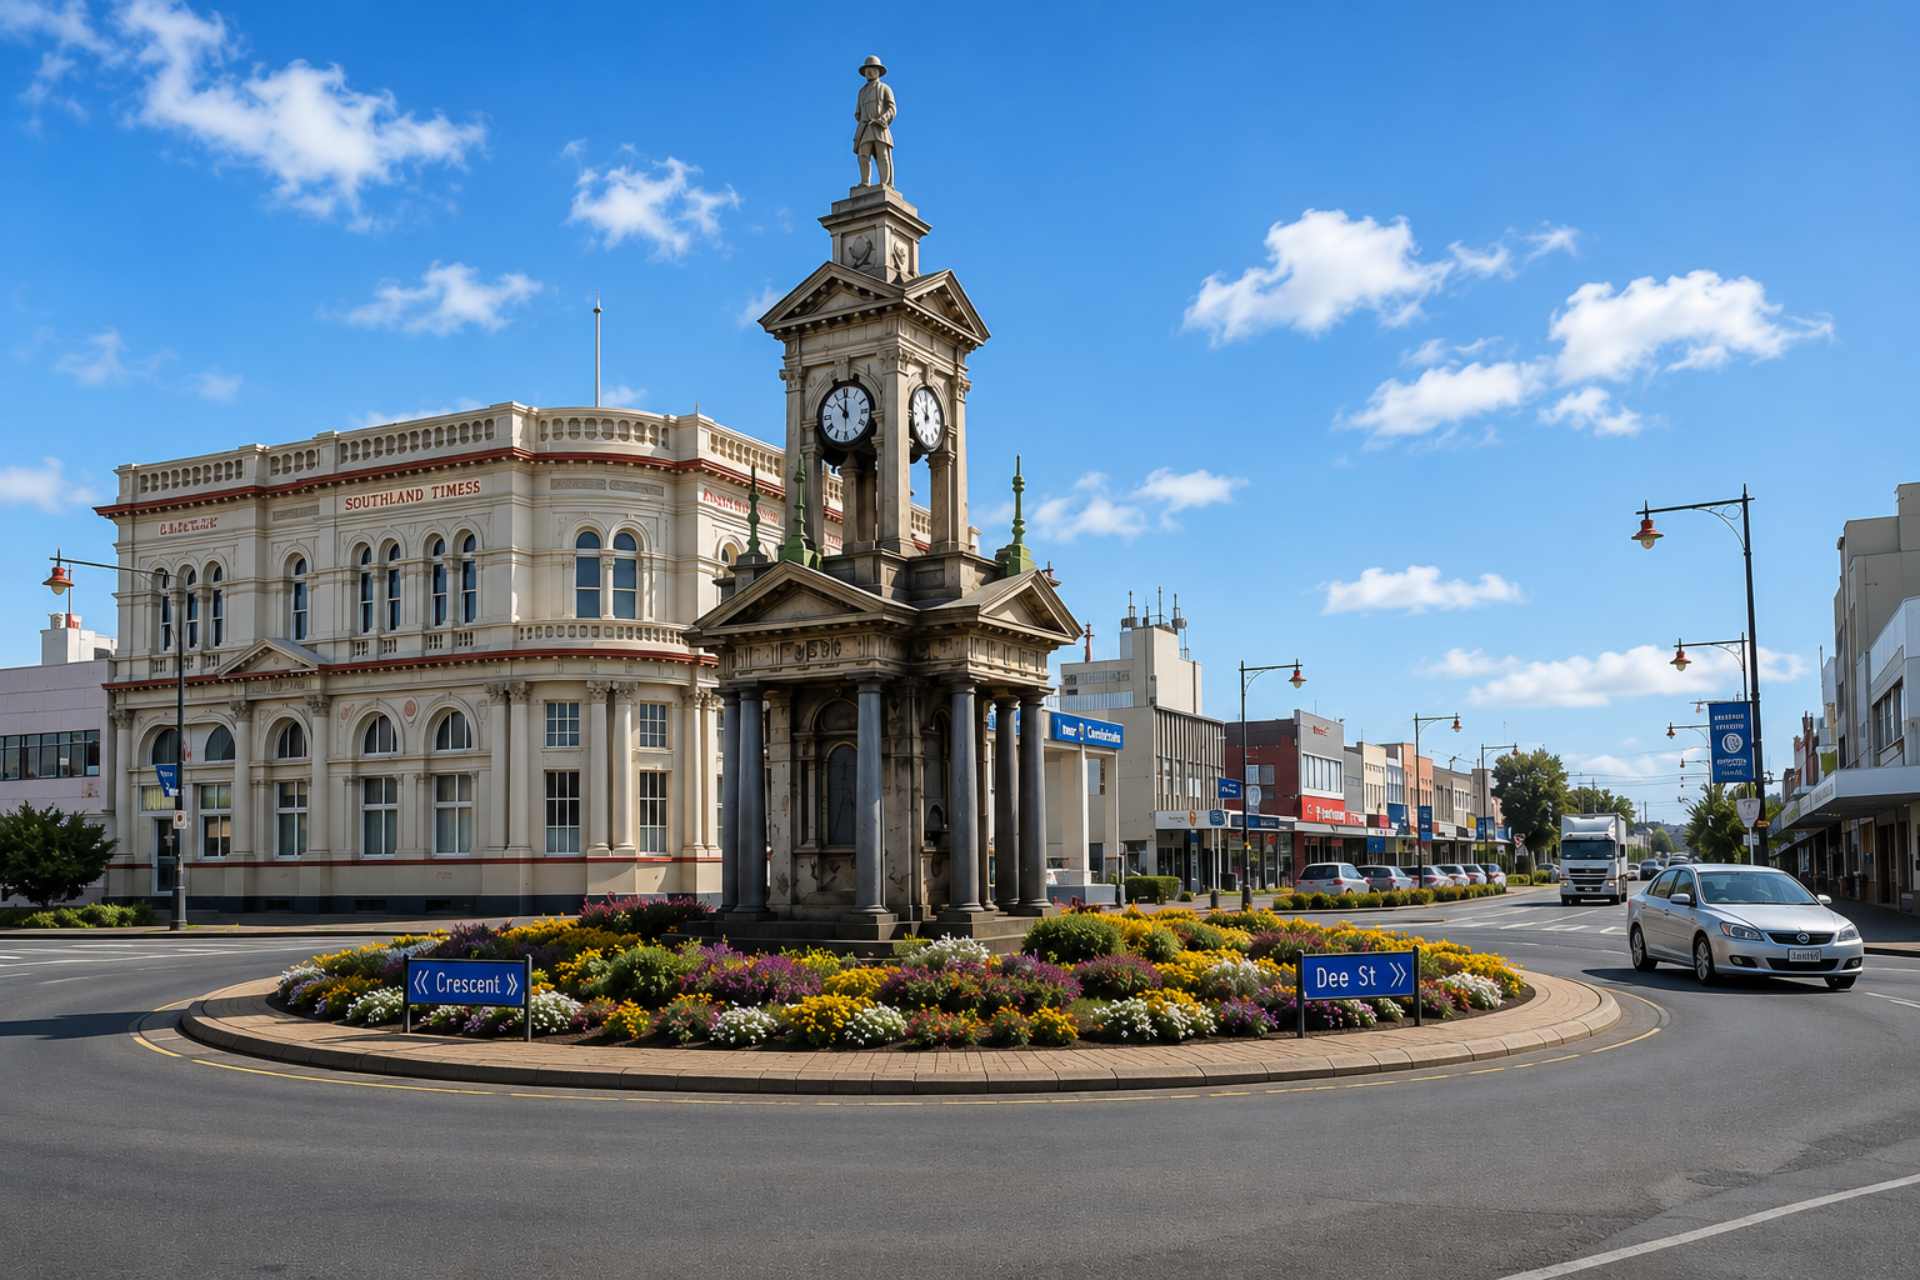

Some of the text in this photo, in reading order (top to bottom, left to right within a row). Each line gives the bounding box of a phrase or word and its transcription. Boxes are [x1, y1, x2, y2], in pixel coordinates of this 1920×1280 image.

[345, 480, 480, 510] SOUTHLAND TIMESS
[436, 972, 501, 994] Crescent
[1316, 965, 1377, 988] Dee St
